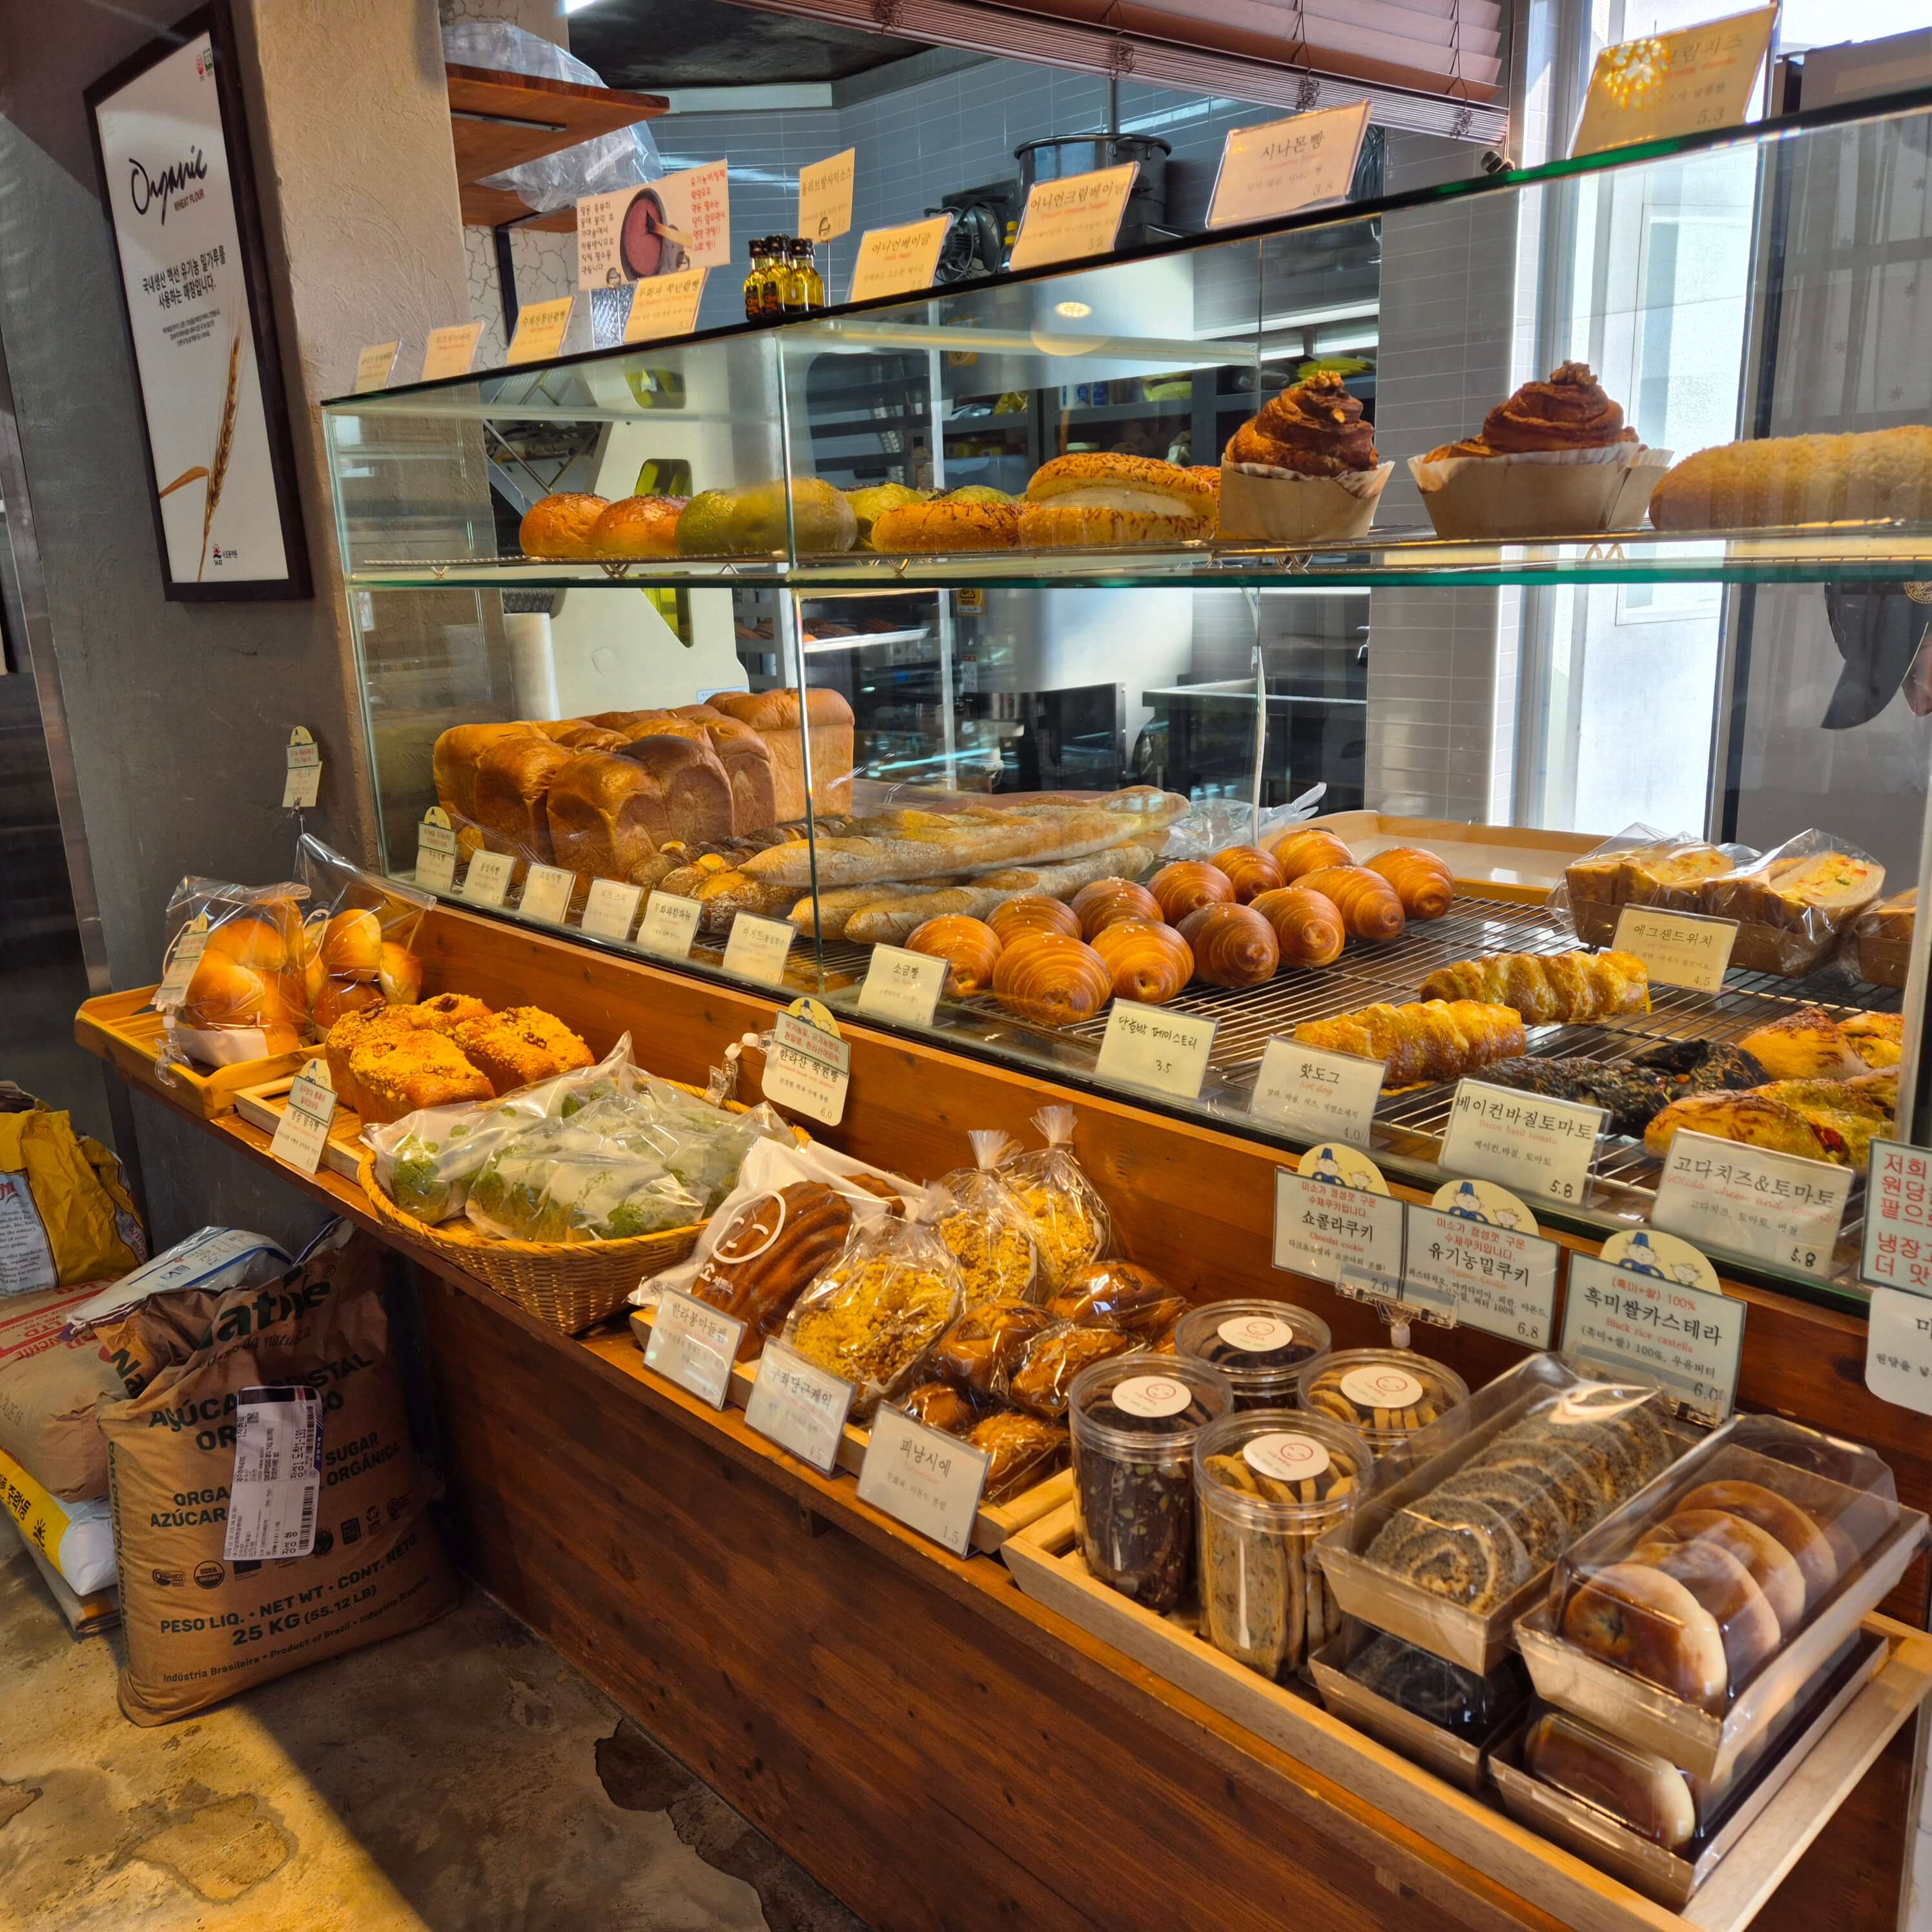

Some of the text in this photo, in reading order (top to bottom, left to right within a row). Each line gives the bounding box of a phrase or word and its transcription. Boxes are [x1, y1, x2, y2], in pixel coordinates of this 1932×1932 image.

[1262, 130, 1325, 160] 시나몬빵
[129, 145, 207, 226] Organic
[801, 166, 852, 197] 올리브발사믹소스
[1031, 181, 1127, 212] 어니언크림베이글
[872, 233, 931, 255] 어니언베이글
[143, 271, 166, 294] 국내생산
[181, 258, 199, 280] 유기농
[200, 245, 226, 272] 밀가루를
[159, 273, 216, 309] 사용하는 매장입니다.
[1634, 924, 1712, 948] 에그샌드위치
[892, 963, 919, 979] 소금빵
[1694, 976, 1711, 986] 4.5
[1118, 1015, 1197, 1050] 단호박 페이스트리
[780, 1049, 807, 1069] 한라산
[1156, 1060, 1173, 1073] 3.5
[1300, 1063, 1339, 1084] 핫도그
[821, 1108, 832, 1119] 6.0
[1456, 1095, 1592, 1140] 베이컨바질토마토
[1342, 1127, 1360, 1140] 4.0
[1506, 1126, 1525, 1137] basil
[1528, 1132, 1557, 1145] tomato
[1525, 1153, 1552, 1166] 토마토
[1550, 1180, 1574, 1198] 5.8
[1673, 1156, 1834, 1209] 고다치즈&토마토
[1301, 1182, 1326, 1198] 미소가
[1360, 1195, 1377, 1208] 구운
[1308, 1196, 1370, 1219] 수제쿠키입니다.
[1689, 1201, 1731, 1219] 고다치즈,
[1738, 1213, 1770, 1229] 토마토,
[1301, 1210, 1373, 1242] 쇼콜라쿠키
[1437, 1217, 1526, 1251] 미소가 정성껏 구운
[1310, 1231, 1364, 1253] Chocolat cookie
[1444, 1232, 1517, 1262] 수제쿠키입니다.
[1428, 1242, 1530, 1287] 유기농밀쿠키
[1791, 1247, 1816, 1268] 5.8
[1875, 1255, 1894, 1277] 더
[1371, 1277, 1390, 1293] 7.0
[1446, 1265, 1475, 1282] Organic
[1612, 1277, 1696, 1311] (흑미+쌀) 100%
[1494, 1302, 1516, 1317] 100%
[1521, 1304, 1549, 1320] 아몬드,
[1585, 1286, 1722, 1346] 흑미쌀카스테라
[1517, 1322, 1539, 1340] 6.8
[1607, 1317, 1693, 1354] Black rice castella
[1581, 1326, 1630, 1350] (흑미+쌀)
[1672, 1357, 1716, 1378] 우유버터
[1694, 1382, 1718, 1401] 6.0
[325, 1433, 378, 1465] SUGAR
[900, 1439, 951, 1477] 피낭시에
[150, 1506, 227, 1528] AZÚCAR
[943, 1526, 959, 1544] 1.5
[200, 1566, 218, 1575] USDA
[161, 1617, 205, 1634] PESO
[209, 1615, 245, 1629] LIQ.
[260, 1597, 294, 1618] NET
[300, 1586, 324, 1605] WT
[338, 1560, 384, 1590] CONT.
[232, 1584, 377, 1646] 25 KG (55.12 LB)
[271, 1640, 310, 1658] Product
[313, 1633, 322, 1643] of
[324, 1623, 351, 1639] Brazil
